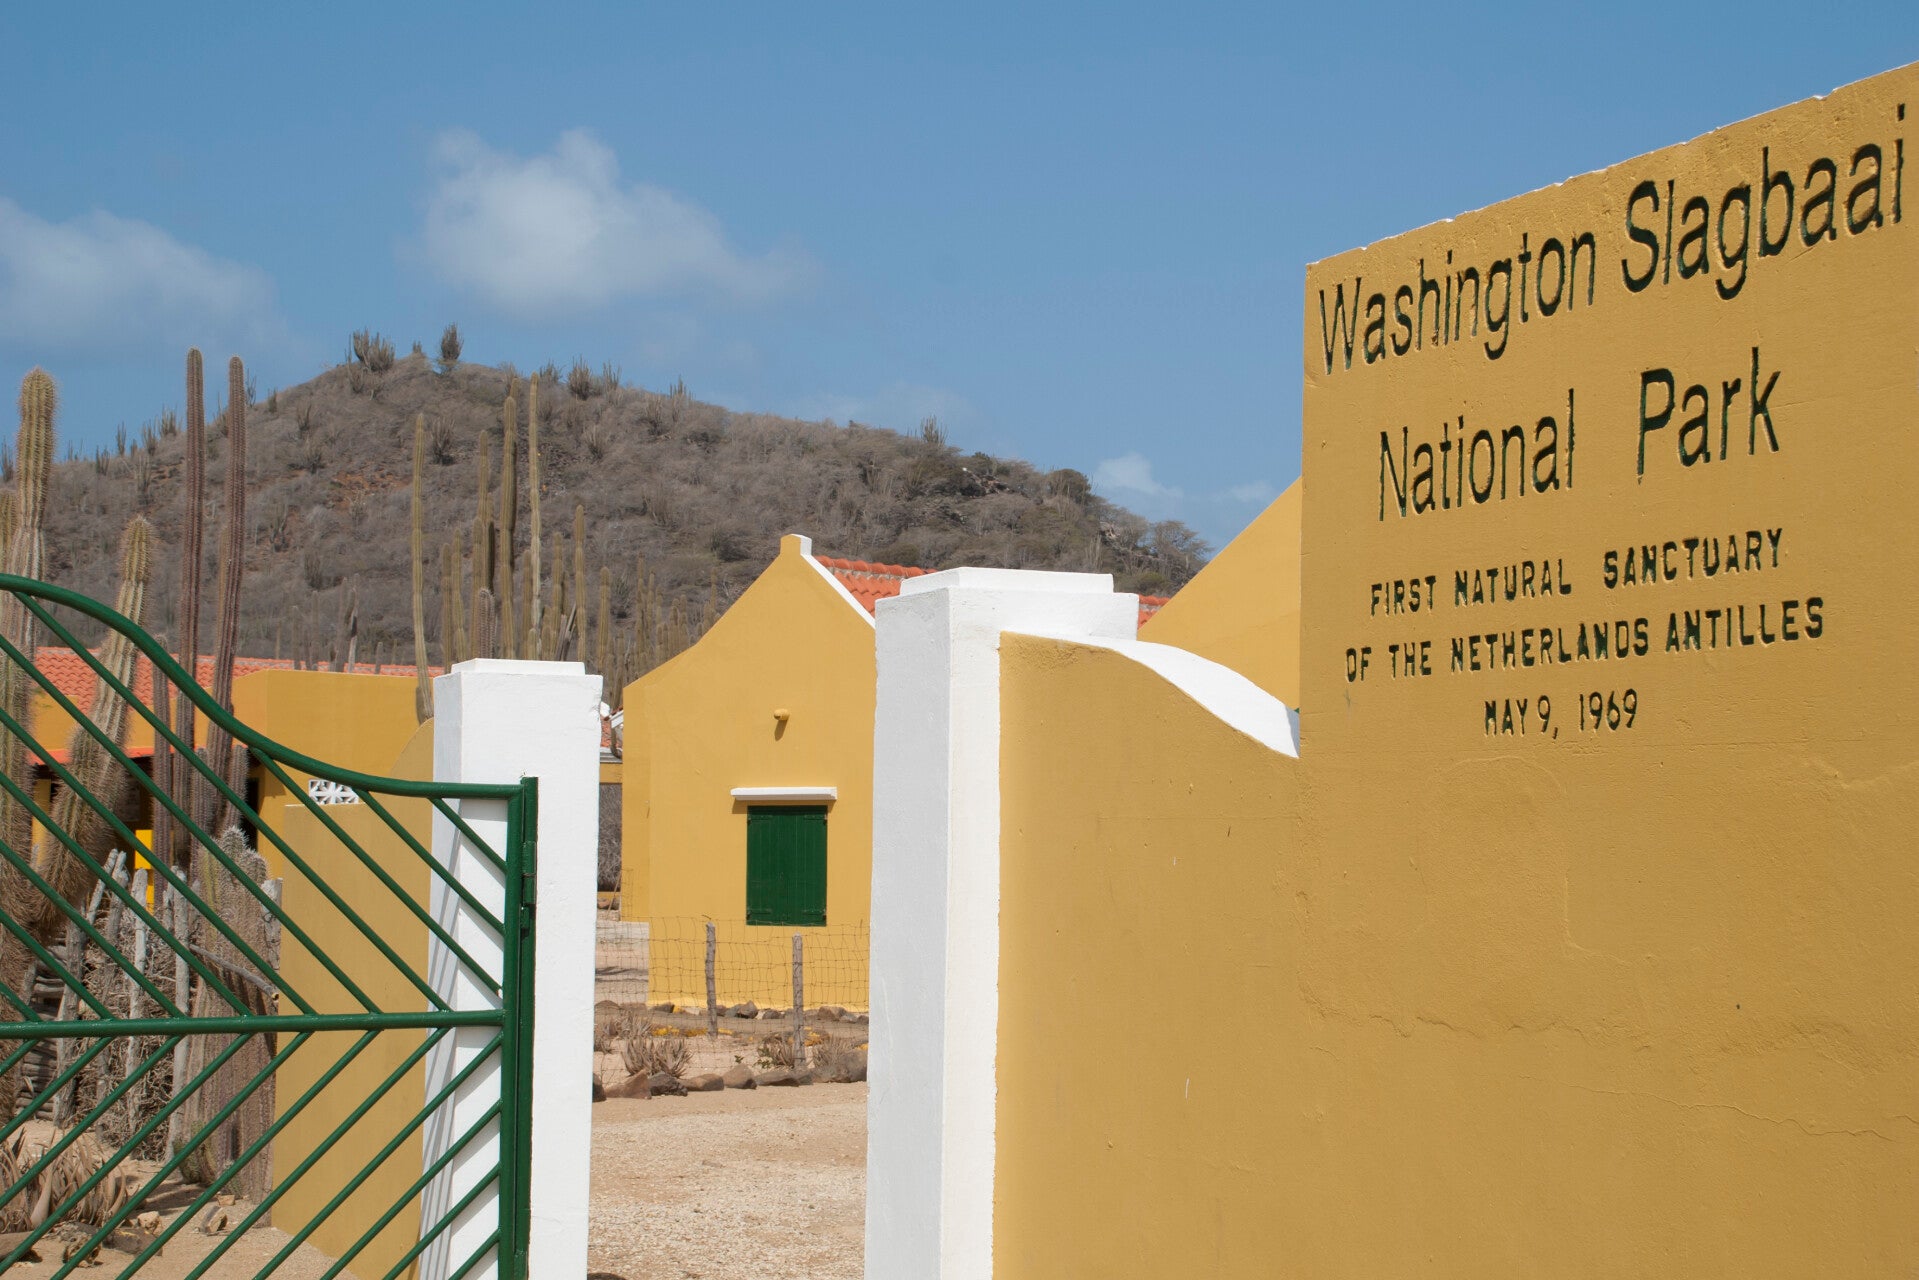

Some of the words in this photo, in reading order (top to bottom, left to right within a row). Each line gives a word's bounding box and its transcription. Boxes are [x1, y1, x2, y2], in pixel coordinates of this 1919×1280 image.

[1318, 231, 1597, 374] Washington
[1620, 103, 1906, 301] Slagbaai
[1380, 388, 1576, 522] National
[1636, 347, 1781, 484] Park
[1371, 576, 1437, 617] FIRST
[1455, 559, 1572, 606] NATURAL
[1604, 528, 1783, 589] SANCTUARY
[1346, 647, 1371, 683] OF
[1389, 641, 1432, 678] THE
[1451, 618, 1649, 673] NETHERLANDS
[1666, 597, 1824, 653] ANTILLES
[1485, 699, 1528, 736] MAY
[1538, 695, 1559, 740] 9,
[1580, 689, 1638, 731] 1969
